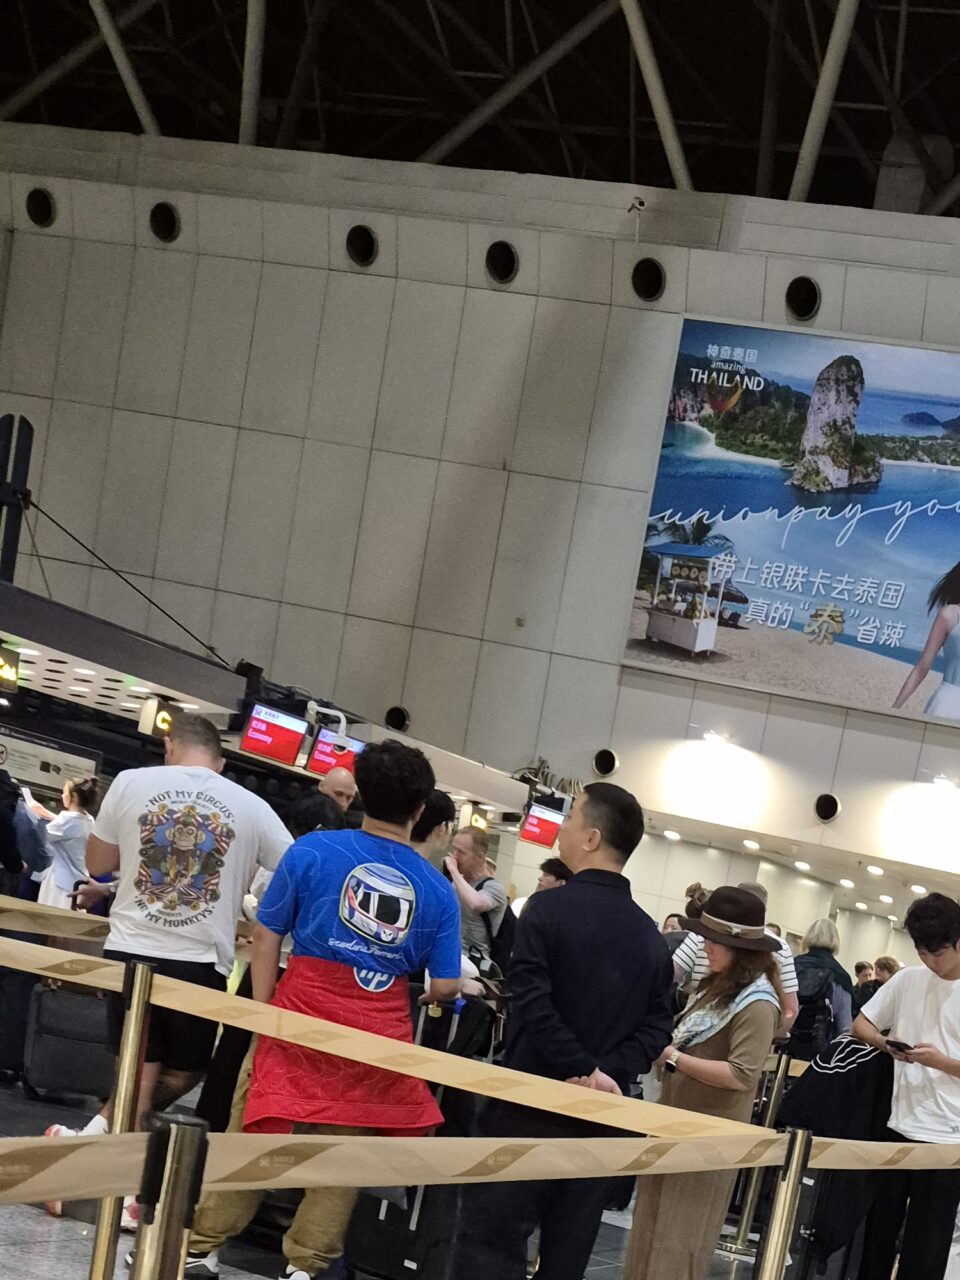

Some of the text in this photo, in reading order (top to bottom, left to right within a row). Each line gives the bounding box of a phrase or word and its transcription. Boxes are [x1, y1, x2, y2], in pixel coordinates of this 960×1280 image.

[706, 343, 759, 363] 神奇泰国
[690, 367, 765, 391] THAILAND
[710, 361, 746, 375] amazing
[649, 500, 864, 549] unionpay
[712, 553, 906, 609] 带上银联卡去泰国
[148, 790, 172, 806] NOT
[175, 790, 193, 799] MY
[196, 791, 234, 819] CIRCUS
[145, 911, 161, 924] MY
[162, 907, 213, 928] MONKEYS
